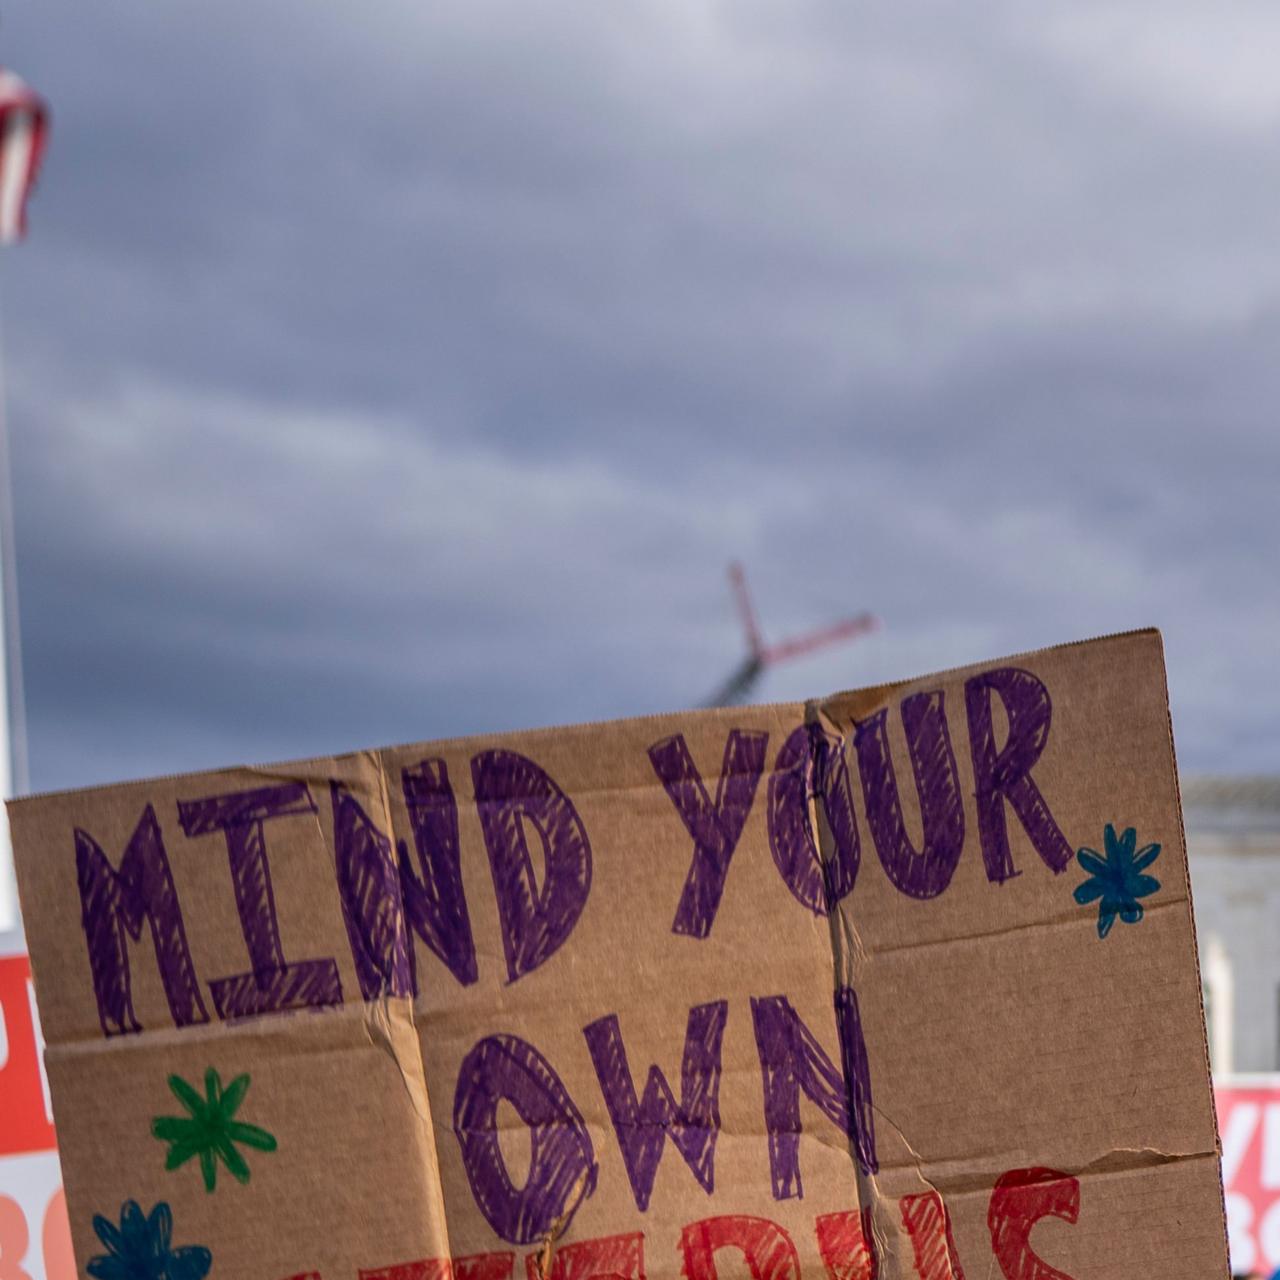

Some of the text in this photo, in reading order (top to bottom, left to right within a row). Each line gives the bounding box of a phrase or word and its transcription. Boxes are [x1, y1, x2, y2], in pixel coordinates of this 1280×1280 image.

[74, 667, 1074, 1037] MIND YOUR
[452, 985, 880, 1246] OWN
